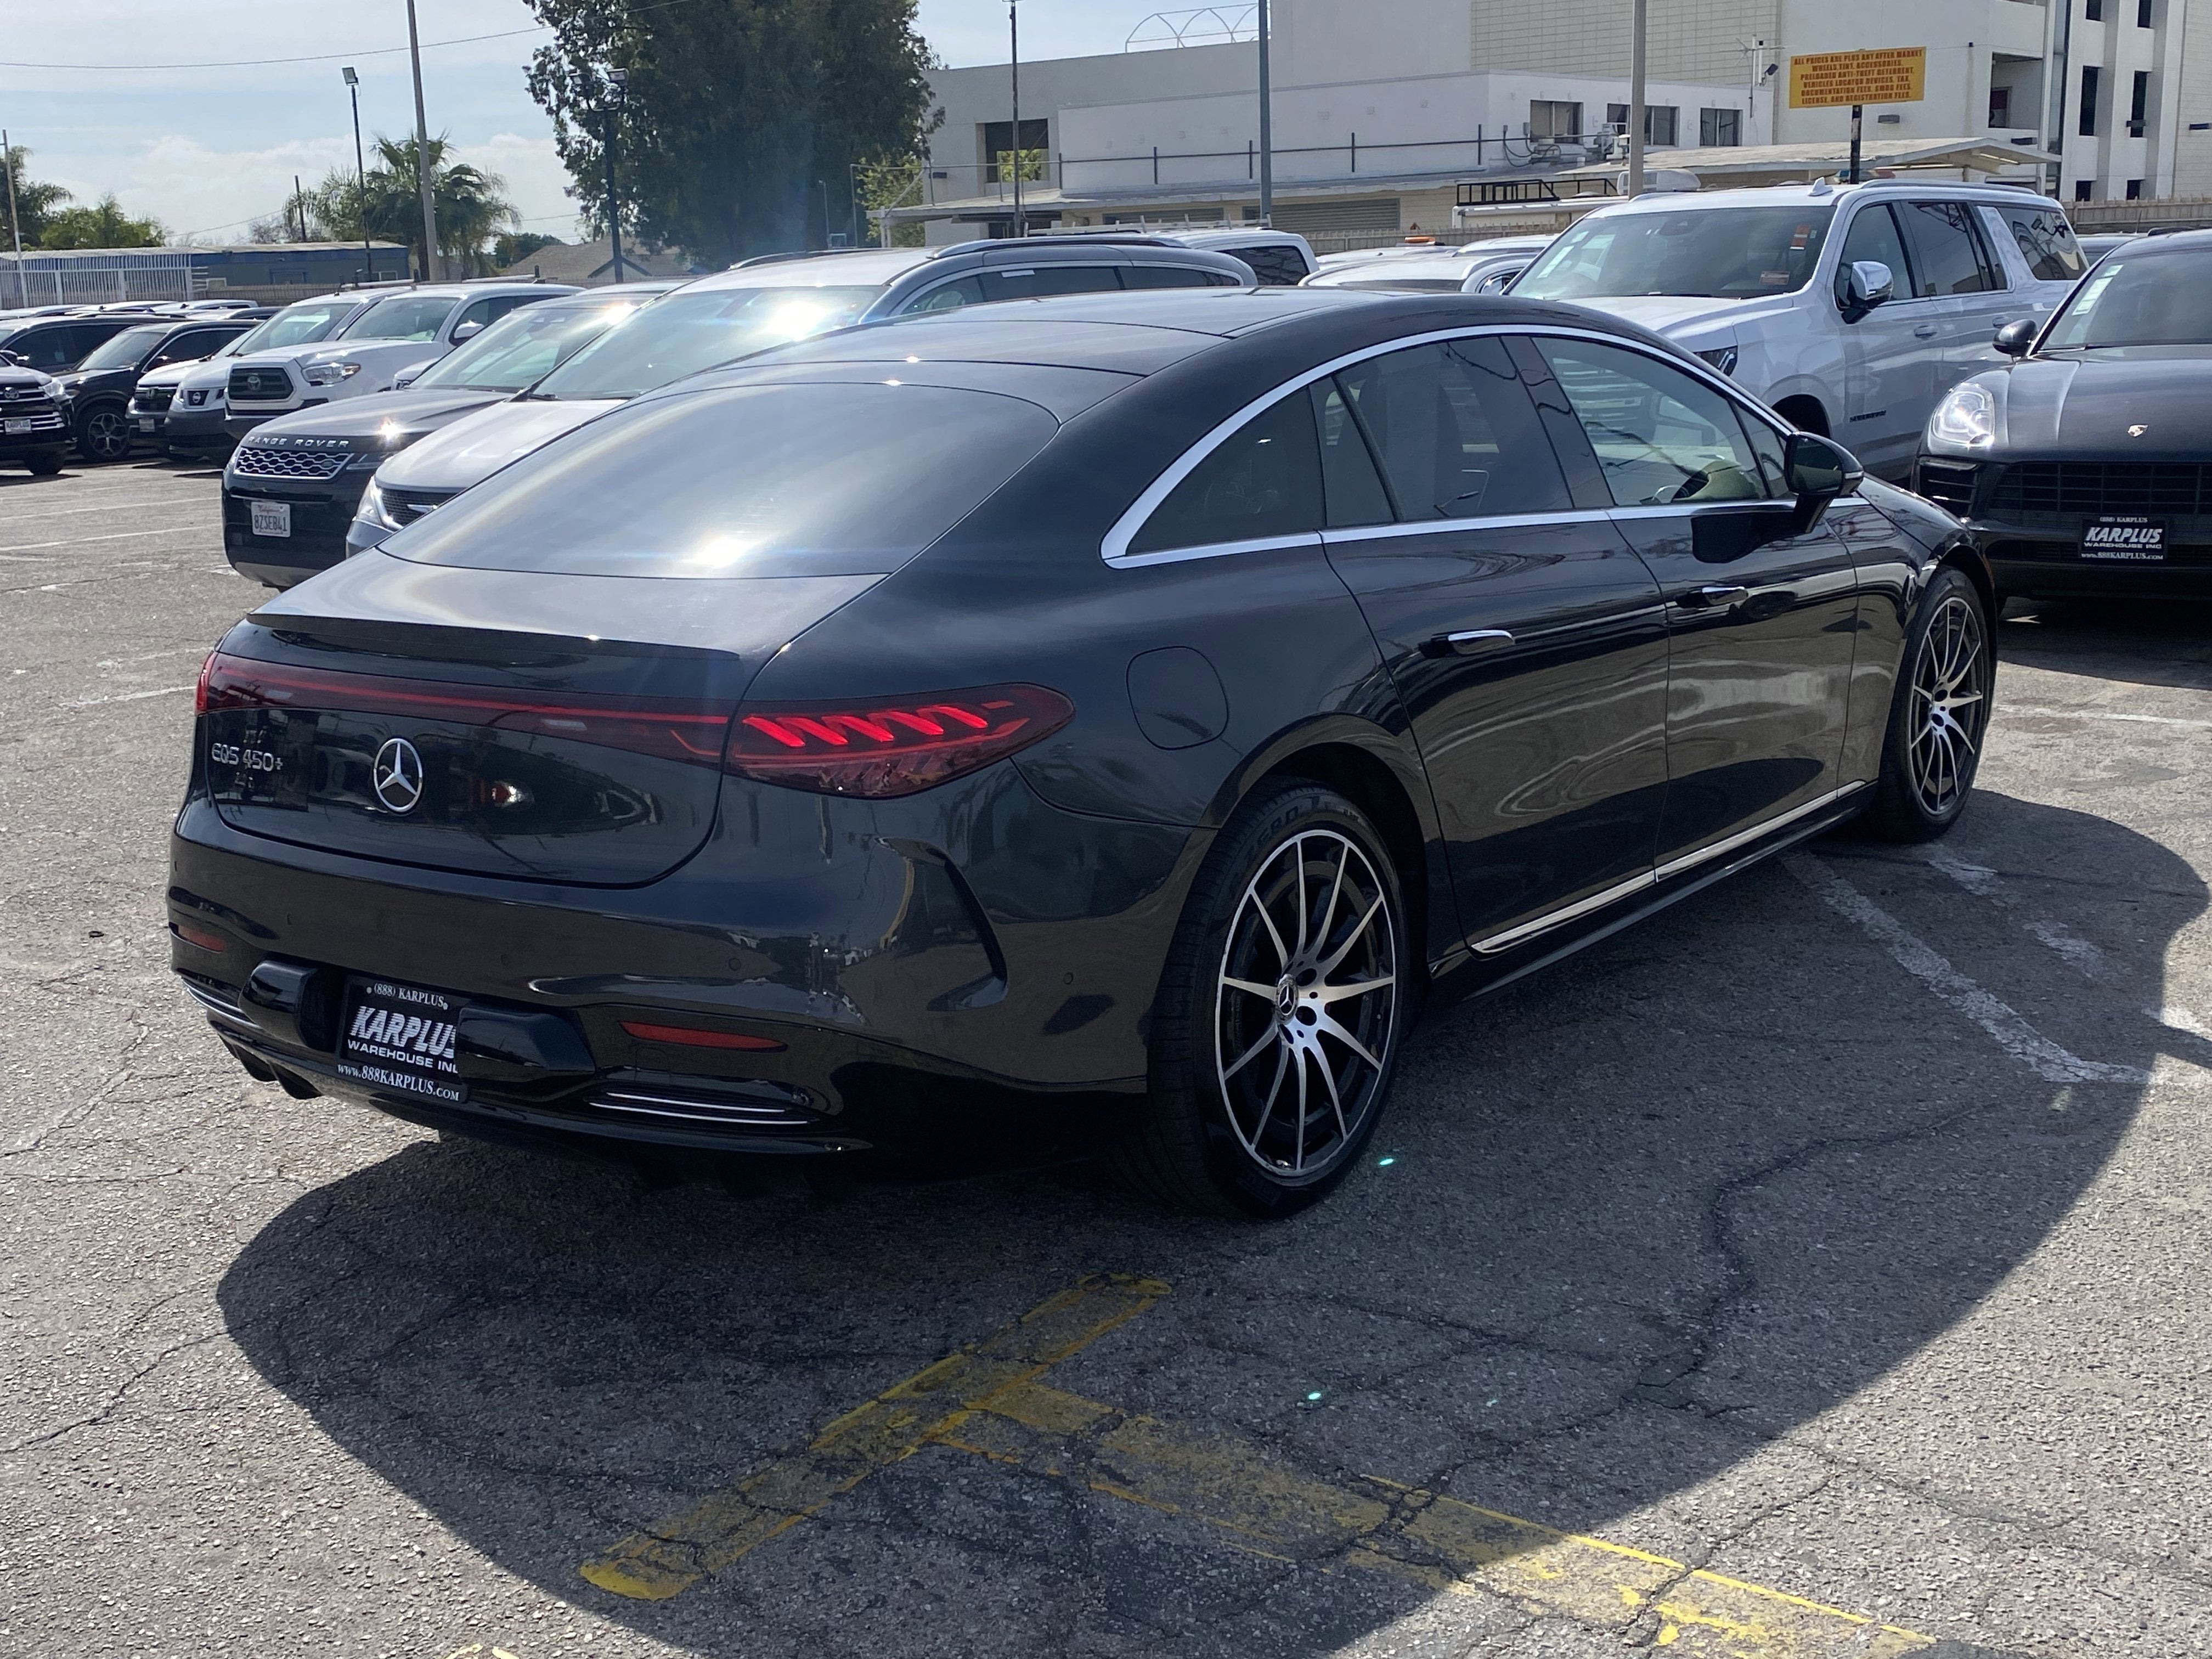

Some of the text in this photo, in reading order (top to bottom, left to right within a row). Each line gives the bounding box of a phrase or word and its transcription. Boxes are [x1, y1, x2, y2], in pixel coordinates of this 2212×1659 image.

[1897, 49, 1922, 58] MARKET
[1800, 72, 1836, 81] PRELOADED
[1838, 69, 1875, 78] ANTI-THEFT
[1803, 80, 1833, 88] VEHICLES
[1835, 78, 1864, 86] LOCATOR
[1801, 87, 1855, 97] DOCUMENTATION
[1845, 92, 1893, 101] REGISTRATION
[247, 436, 349, 448] RANGE ROVER
[2085, 527, 2163, 543] KARPLUS
[211, 742, 240, 766] EQS
[374, 983, 445, 1007] (888) KARPLUS
[347, 1039, 433, 1069] WAREHOUSE
